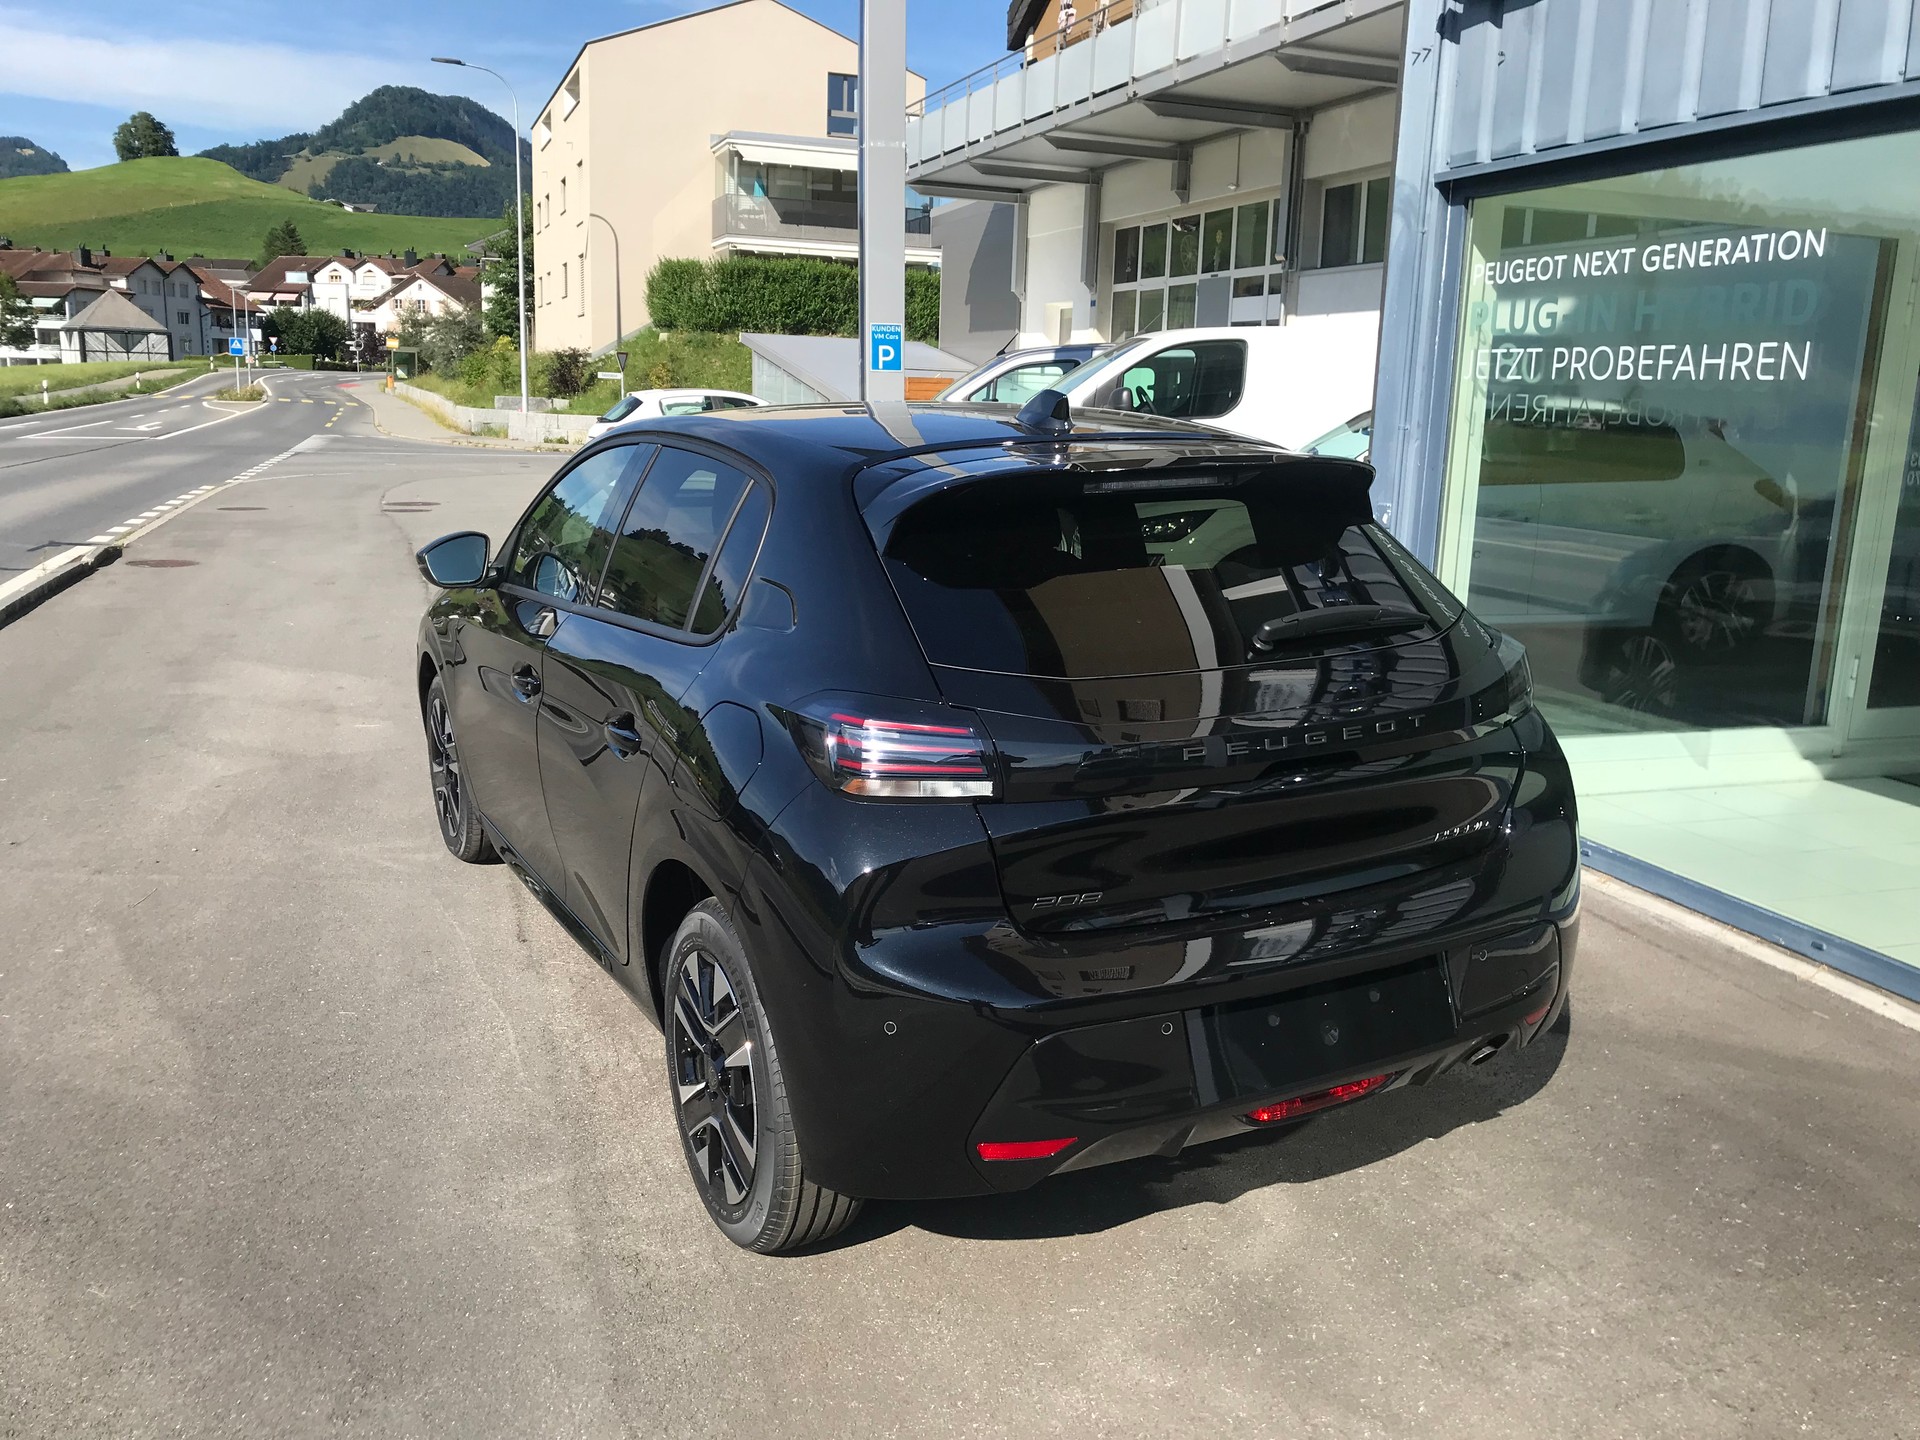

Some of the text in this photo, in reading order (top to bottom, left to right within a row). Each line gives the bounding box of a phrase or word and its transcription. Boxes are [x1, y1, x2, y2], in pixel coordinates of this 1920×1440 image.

[1473, 227, 1827, 286] PEUGEOT NEXT GENERATION
[879, 346, 894, 369] P
[1464, 347, 1544, 380] JETZT
[1551, 340, 1811, 381] PROBEFAHREN
[1182, 713, 1426, 762] PEUGEOT
[1031, 892, 1104, 910] 208
